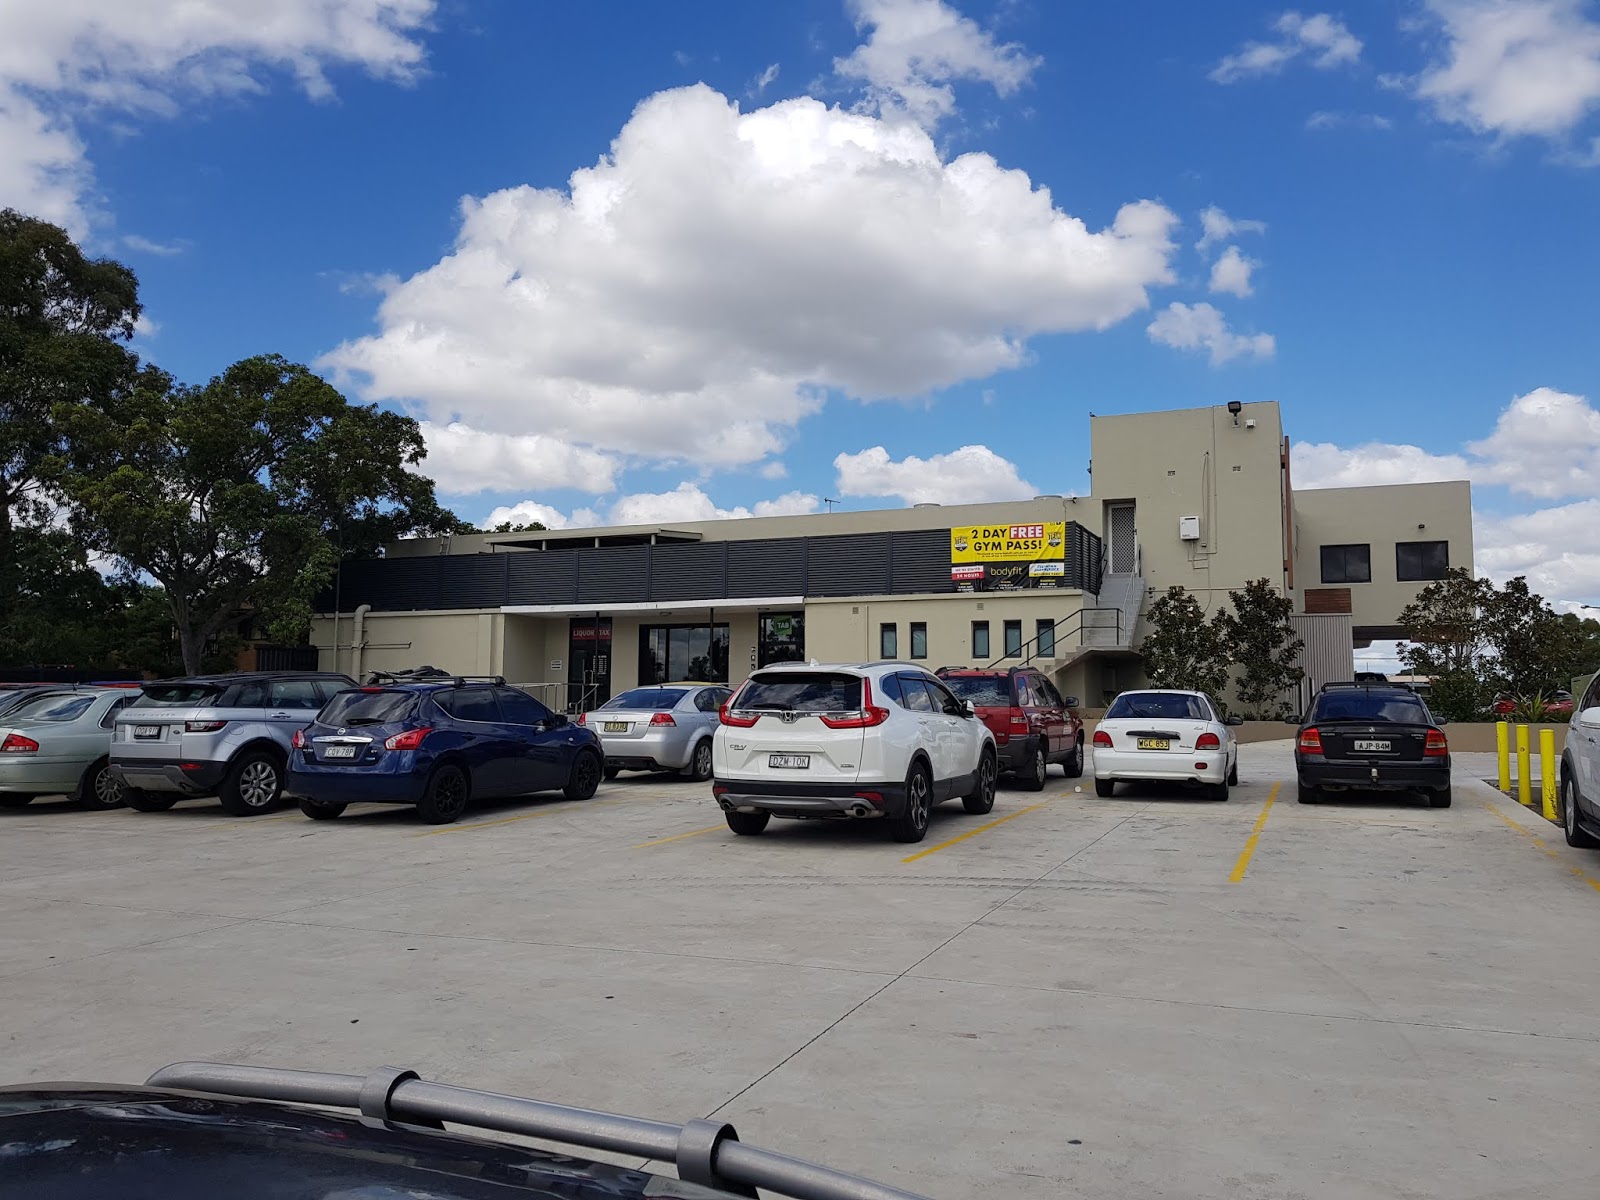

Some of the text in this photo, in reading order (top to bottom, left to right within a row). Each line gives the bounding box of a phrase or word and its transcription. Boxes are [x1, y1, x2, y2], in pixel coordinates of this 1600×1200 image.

[971, 526, 1043, 539] 2 DAY FREE
[973, 540, 1042, 551] GYM PASS!
[990, 566, 1023, 578] bodyfit
[573, 629, 595, 637] LIQUOR
